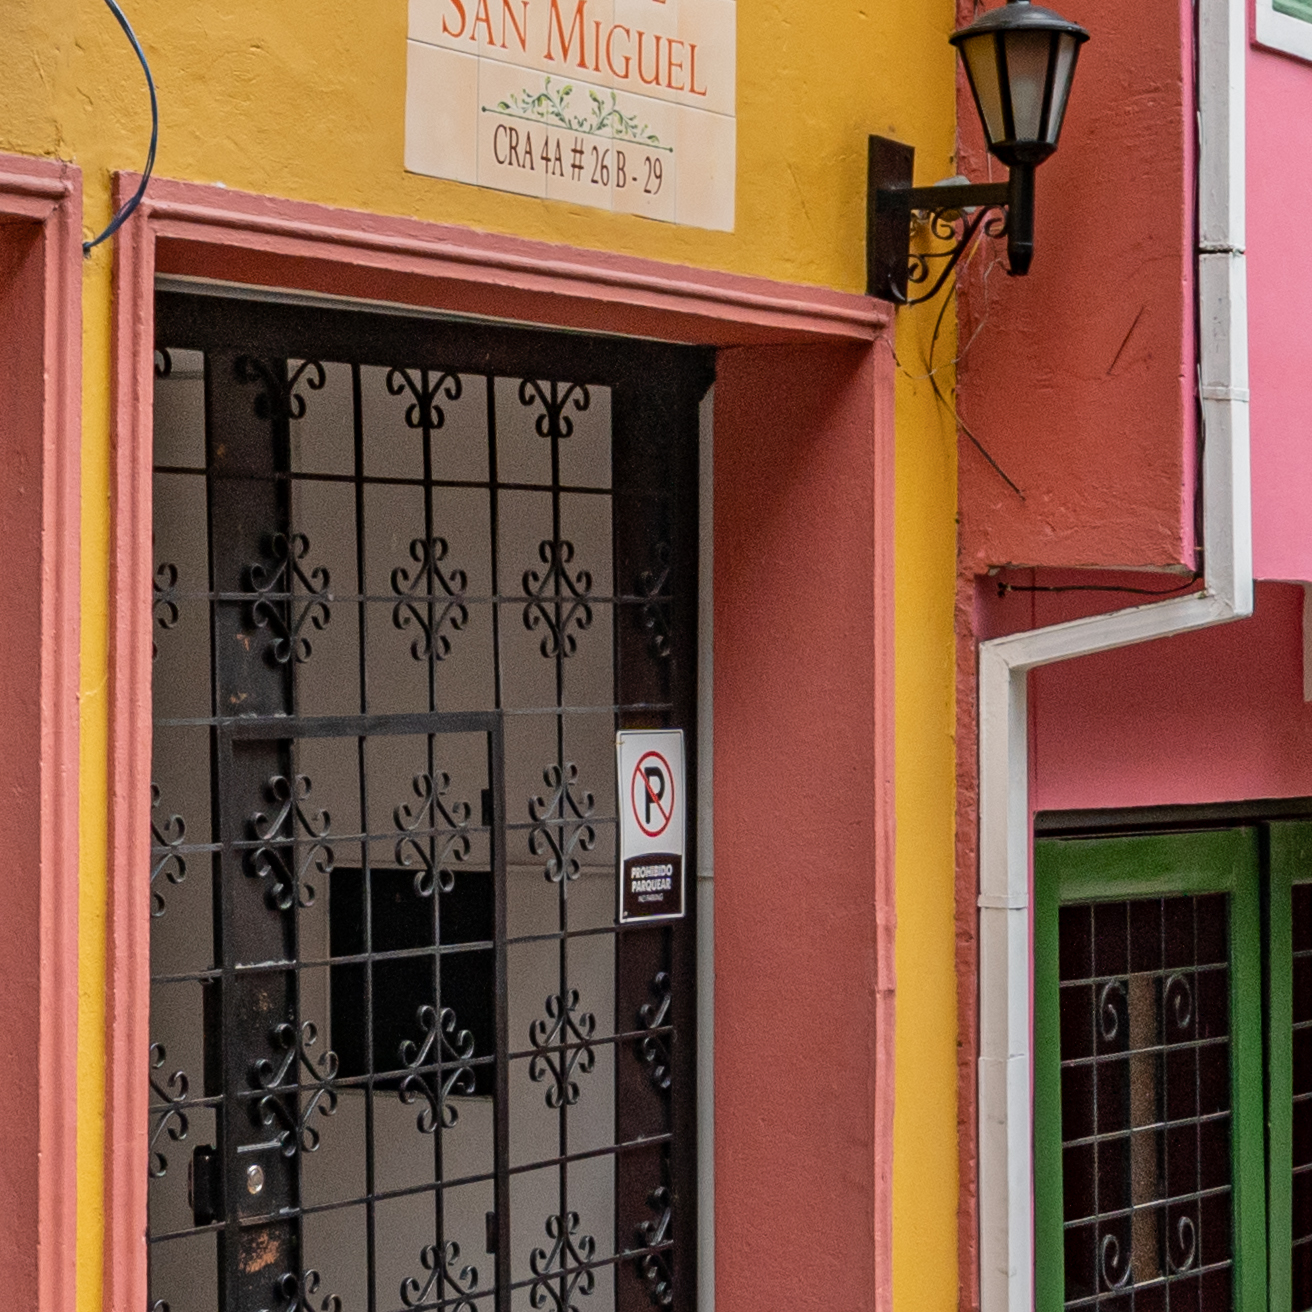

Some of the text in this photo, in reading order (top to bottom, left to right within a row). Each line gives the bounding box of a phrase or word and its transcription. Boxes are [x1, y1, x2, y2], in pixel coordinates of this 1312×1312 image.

[493, 124, 535, 172] CRA
[540, 134, 565, 178] 4A
[643, 155, 663, 196] 29
[631, 863, 673, 879] PROHIBIDO
[631, 877, 672, 893] PARQUEAR
